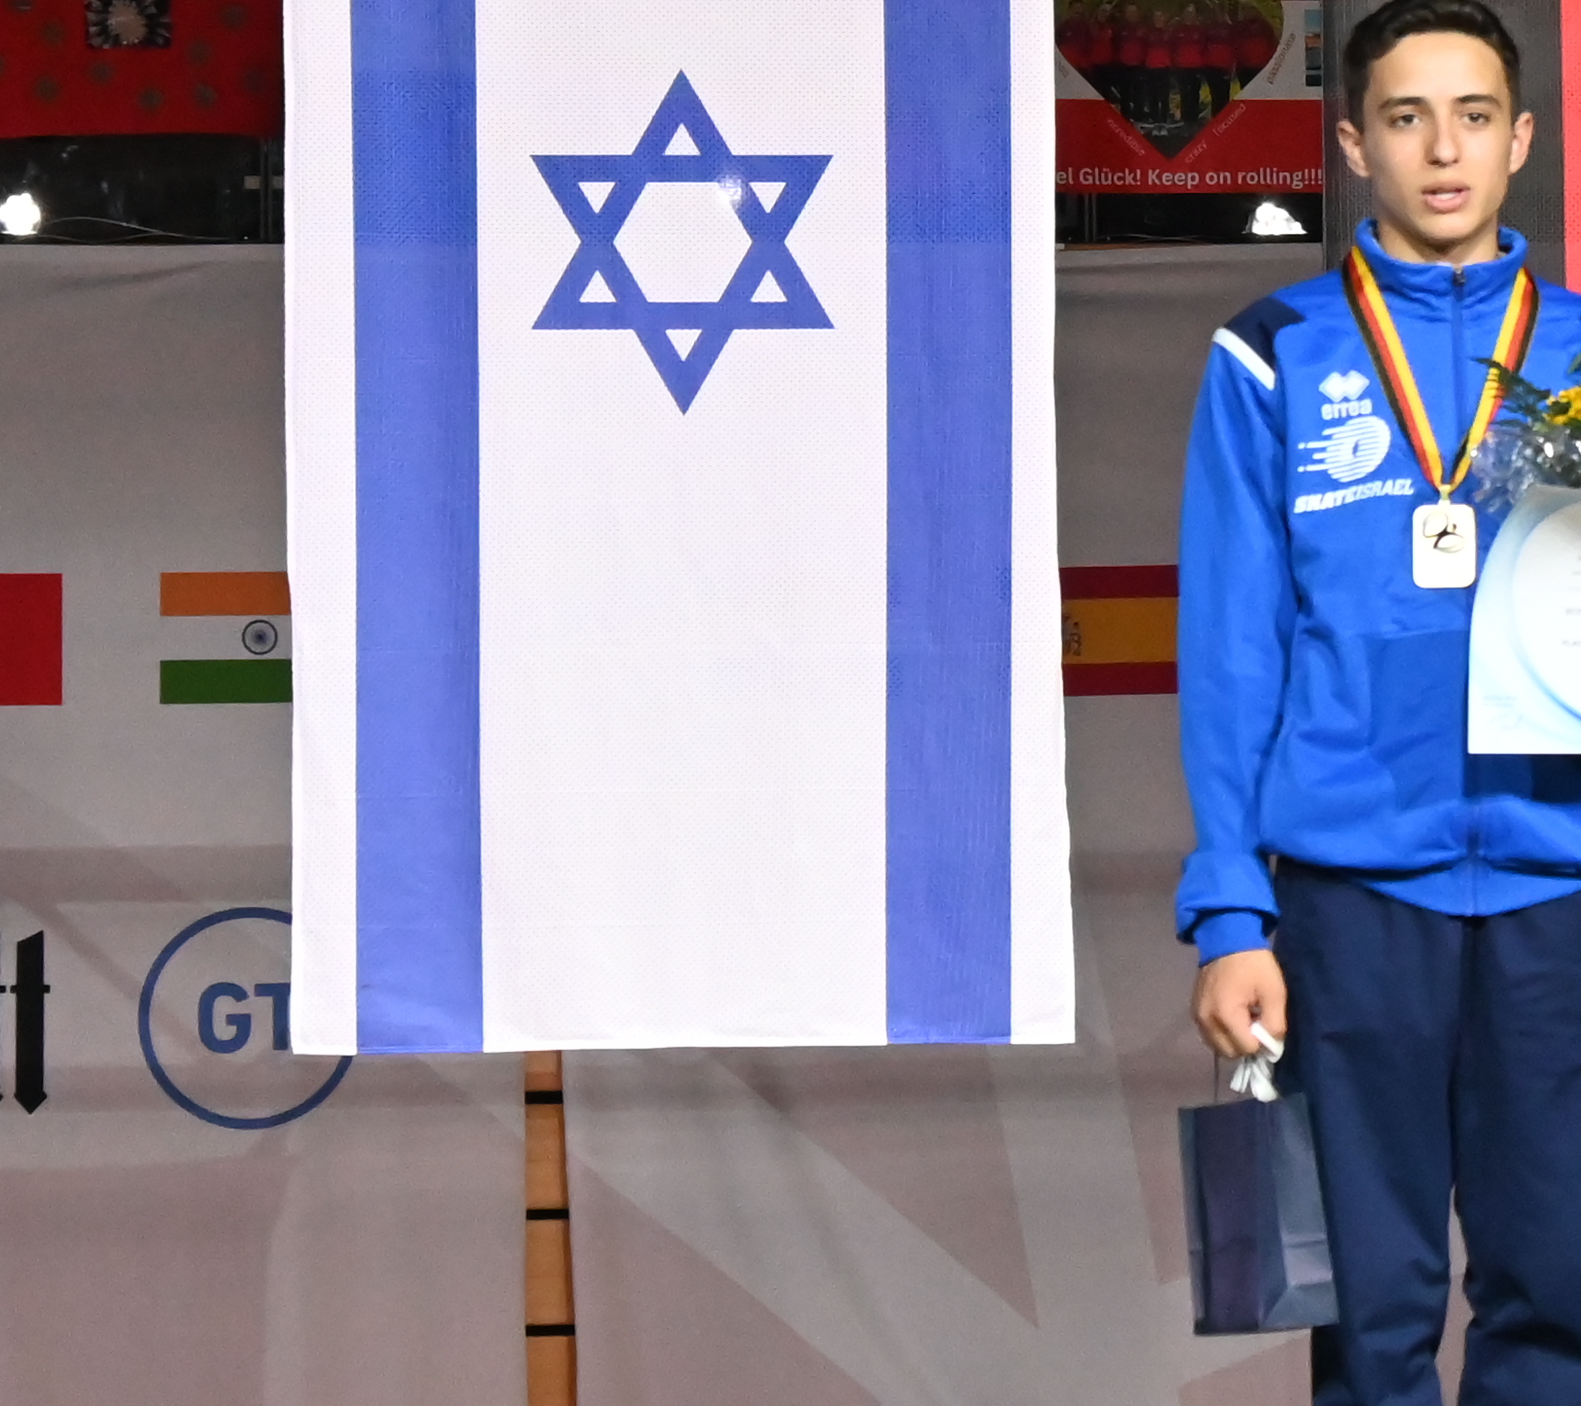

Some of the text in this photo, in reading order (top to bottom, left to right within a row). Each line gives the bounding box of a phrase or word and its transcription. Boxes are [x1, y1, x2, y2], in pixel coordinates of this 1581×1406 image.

[1079, 166, 1141, 186] Glück!
[1147, 167, 1199, 190] Keep
[1205, 172, 1232, 186] on
[1237, 166, 1323, 190] rolling!!!
